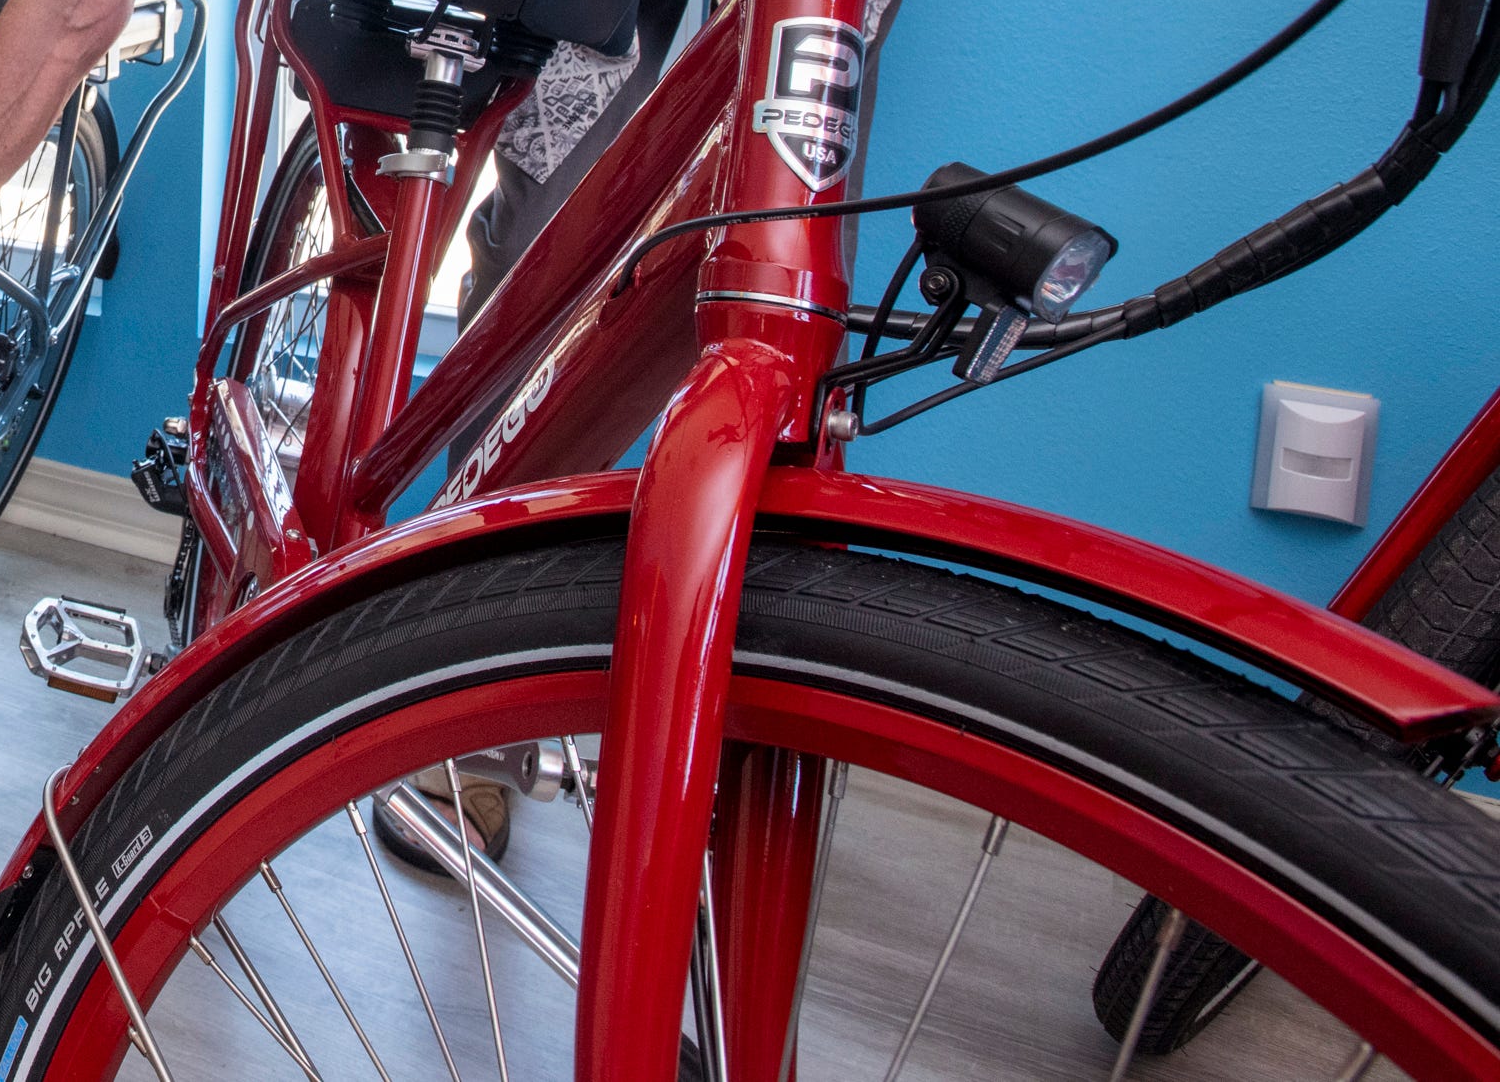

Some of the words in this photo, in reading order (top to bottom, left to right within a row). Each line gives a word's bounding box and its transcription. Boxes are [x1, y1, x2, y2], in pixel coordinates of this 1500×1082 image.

[788, 35, 861, 93] P
[802, 140, 839, 165] USA
[24, 962, 52, 1012] BIG
[53, 876, 110, 961] APPE
